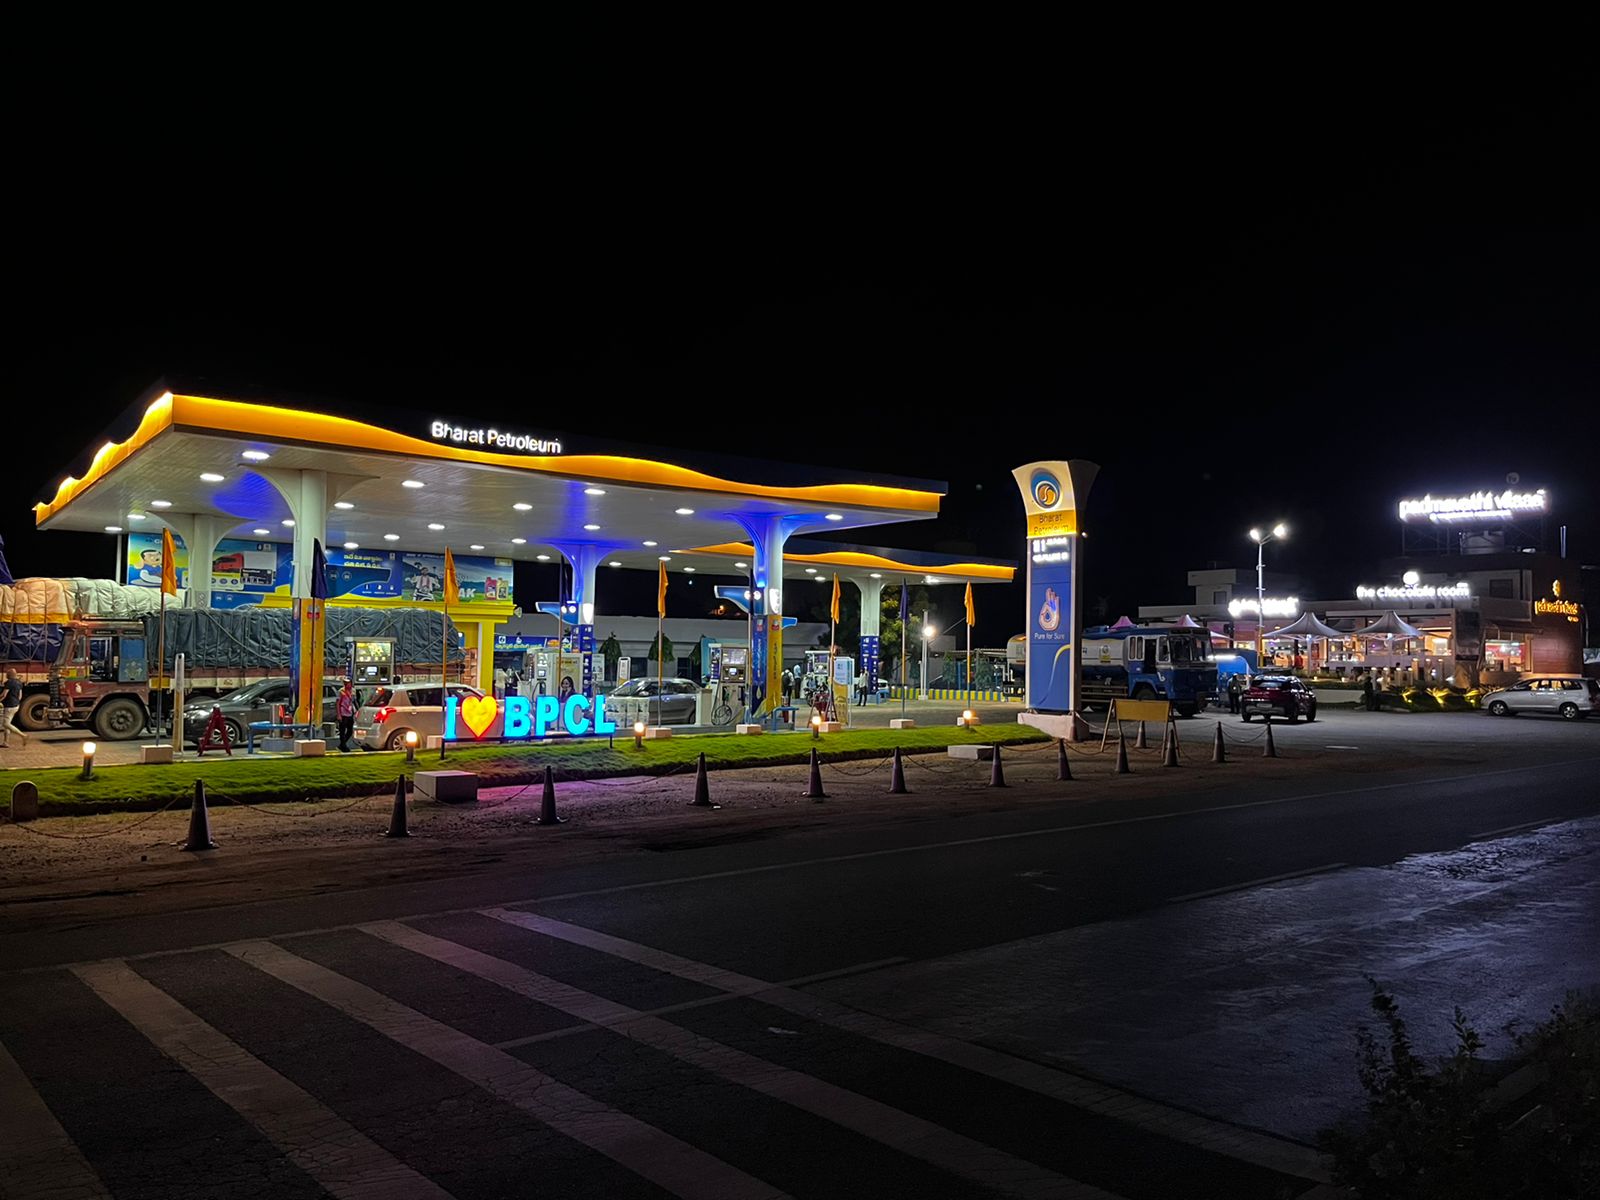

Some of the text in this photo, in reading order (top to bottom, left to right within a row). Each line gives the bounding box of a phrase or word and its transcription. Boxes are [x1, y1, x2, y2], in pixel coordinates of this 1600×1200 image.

[431, 421, 561, 453] Bharat Petroleum
[1039, 513, 1063, 524] Bharat
[1356, 585, 1469, 598] the chocolate room
[1034, 632, 1045, 641] Pure
[1054, 632, 1065, 641] Sure
[445, 694, 616, 740] I BPCL
